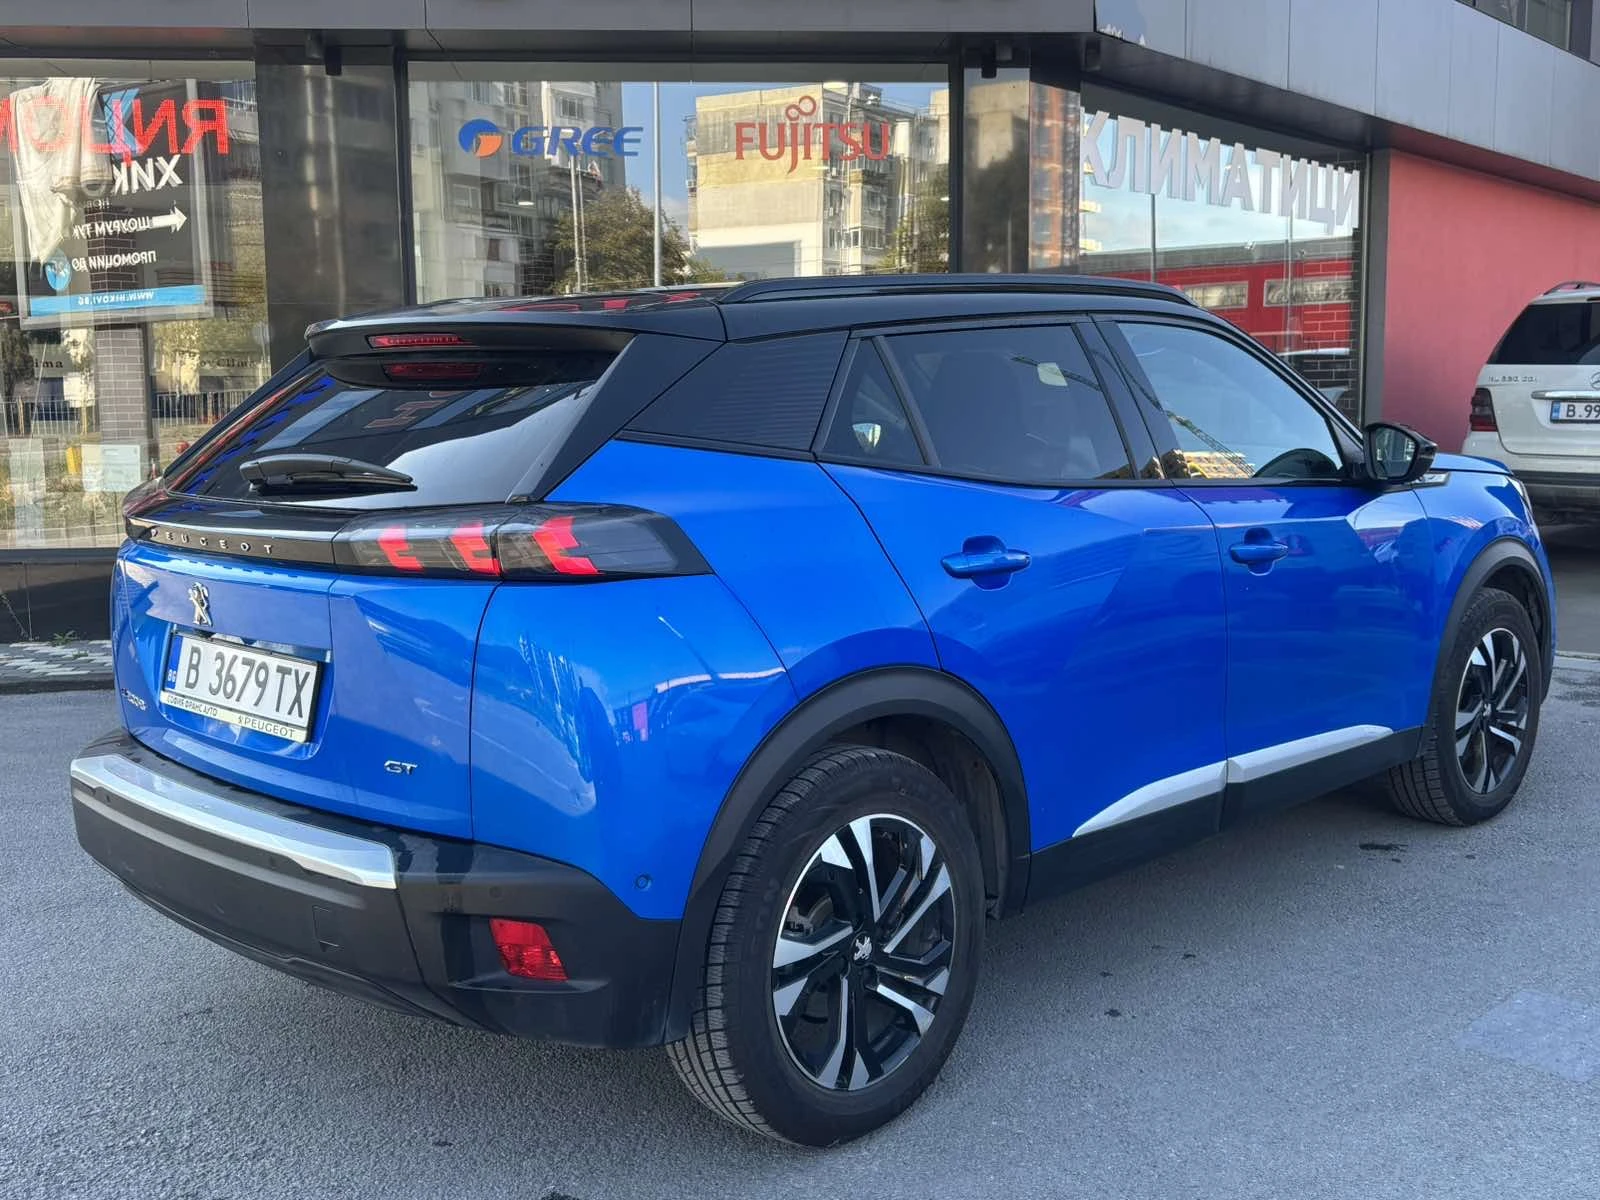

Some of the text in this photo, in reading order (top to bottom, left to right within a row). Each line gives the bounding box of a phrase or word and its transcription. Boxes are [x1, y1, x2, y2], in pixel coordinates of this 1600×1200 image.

[511, 126, 644, 157] GREE
[735, 118, 888, 175] FUJITSU
[1080, 106, 1361, 235] КЛИМАТИЦИ
[150, 528, 273, 555] PEUGEOT
[243, 714, 295, 738] PEUGEOT
[384, 759, 418, 775] GT
